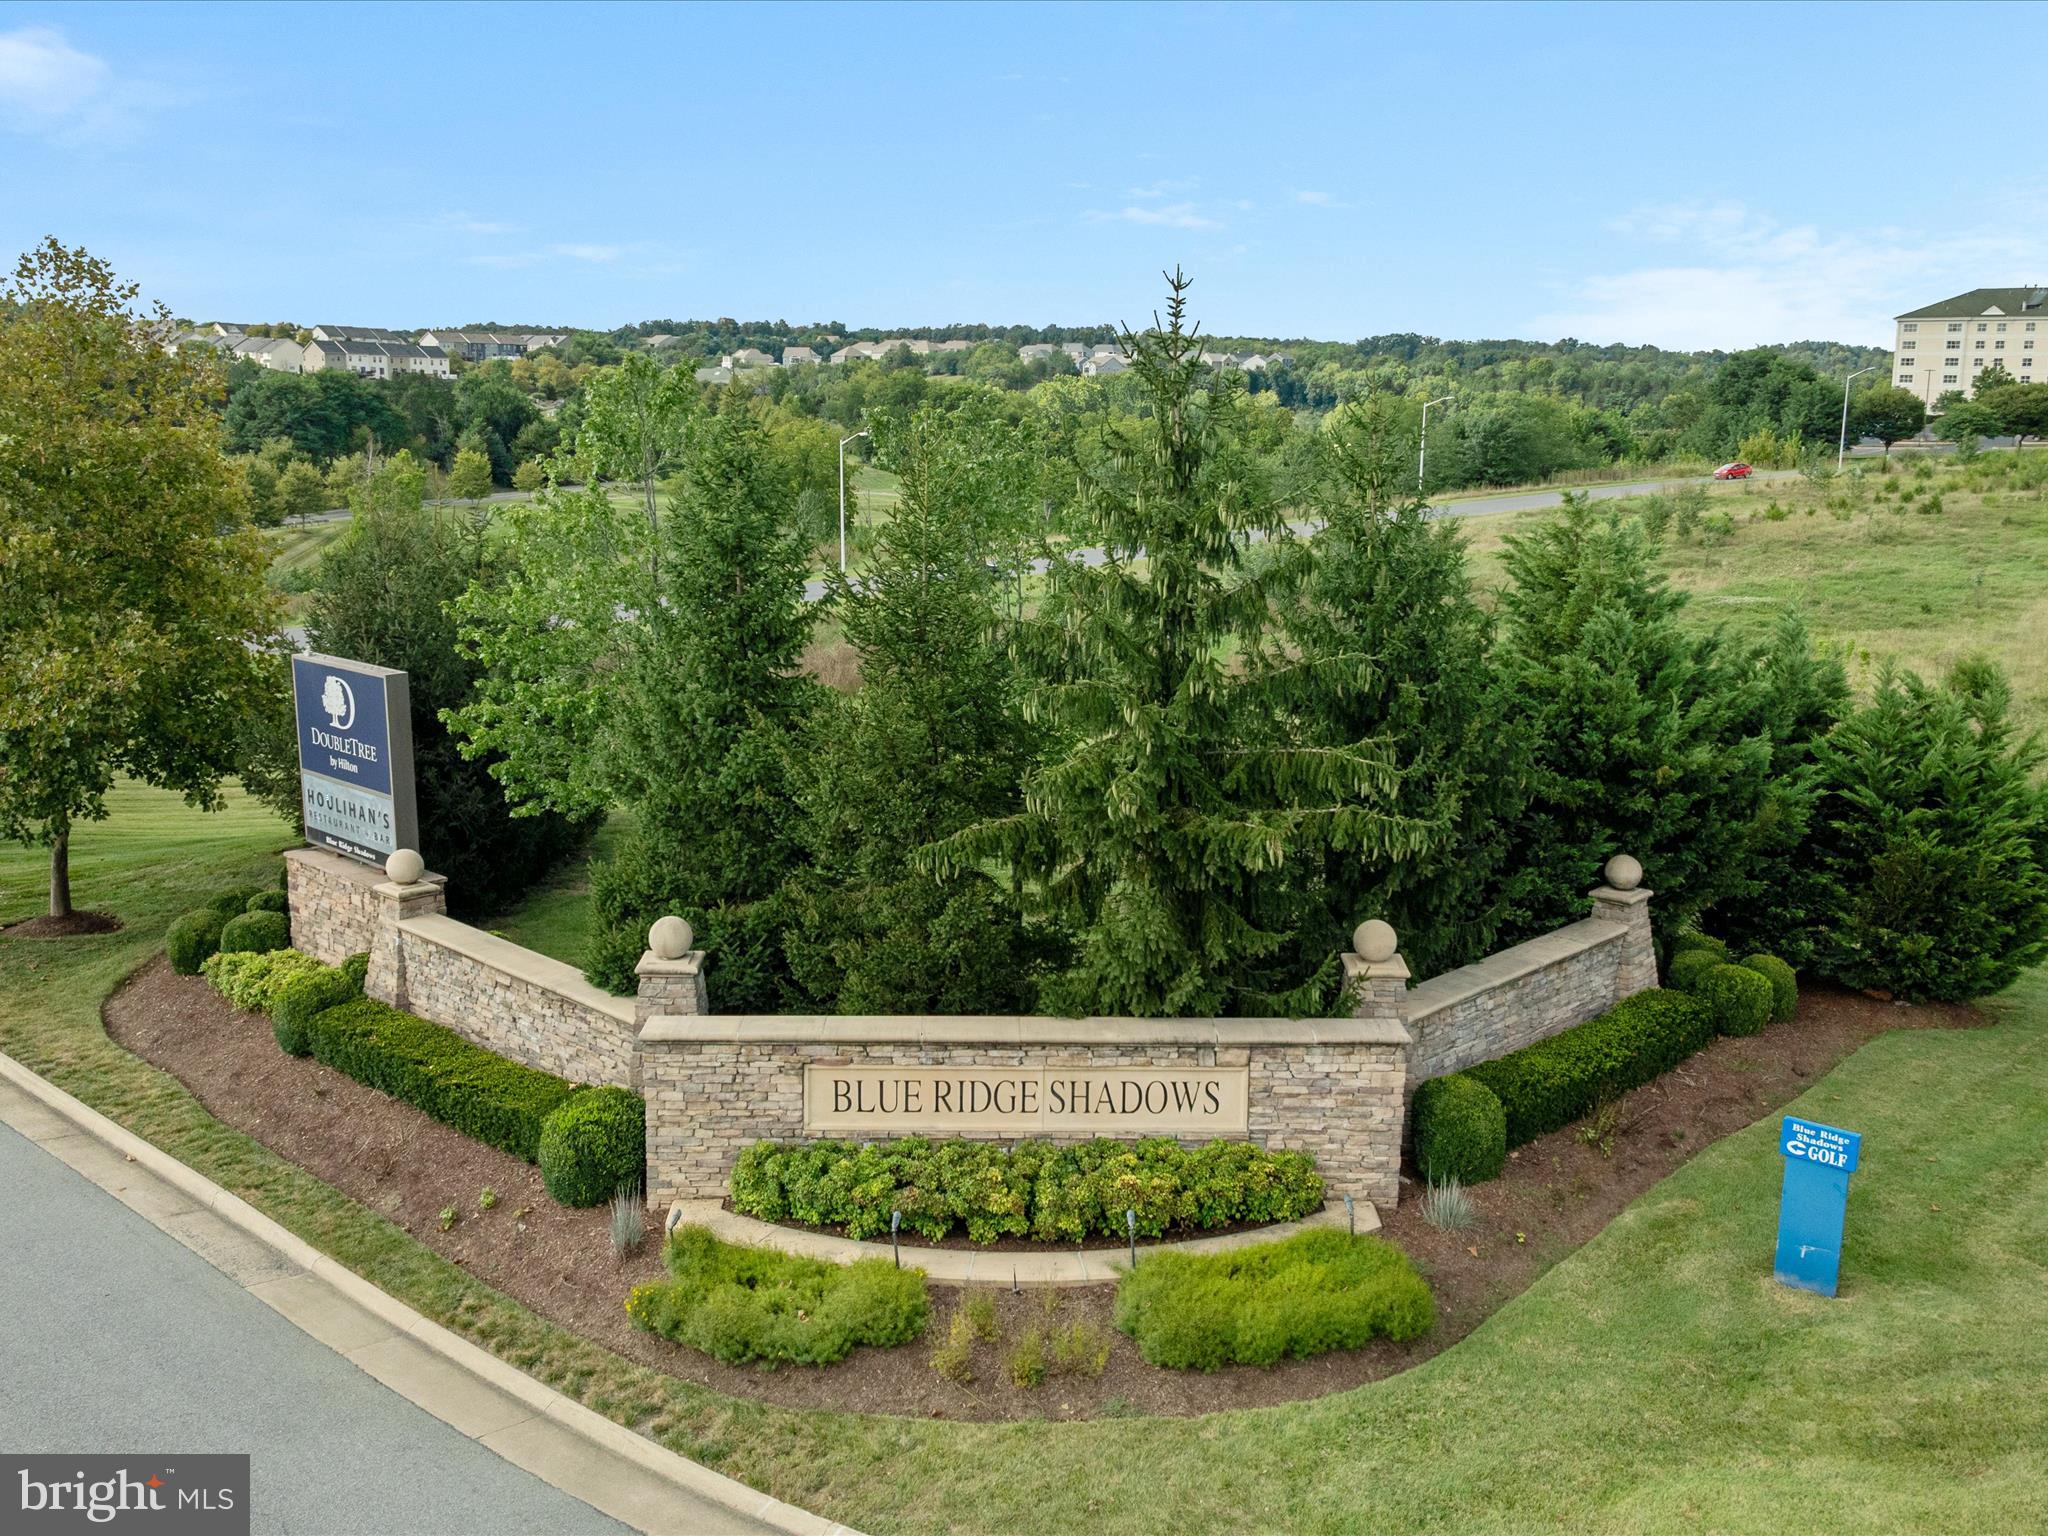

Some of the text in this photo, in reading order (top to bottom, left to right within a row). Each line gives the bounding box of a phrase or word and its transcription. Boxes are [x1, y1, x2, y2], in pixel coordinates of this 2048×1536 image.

[330, 756, 358, 773] by Hilton
[309, 810, 360, 834] RESTAURANT
[373, 832, 390, 844] BAR
[326, 836, 376, 860] Blue Ridge Shadows
[833, 1079, 1220, 1114] BLUE RIDGE SHADOWS
[1792, 1124, 1849, 1145] Blue Ridge
[1796, 1133, 1843, 1152] Shadows
[1808, 1147, 1847, 1167] GOLF
